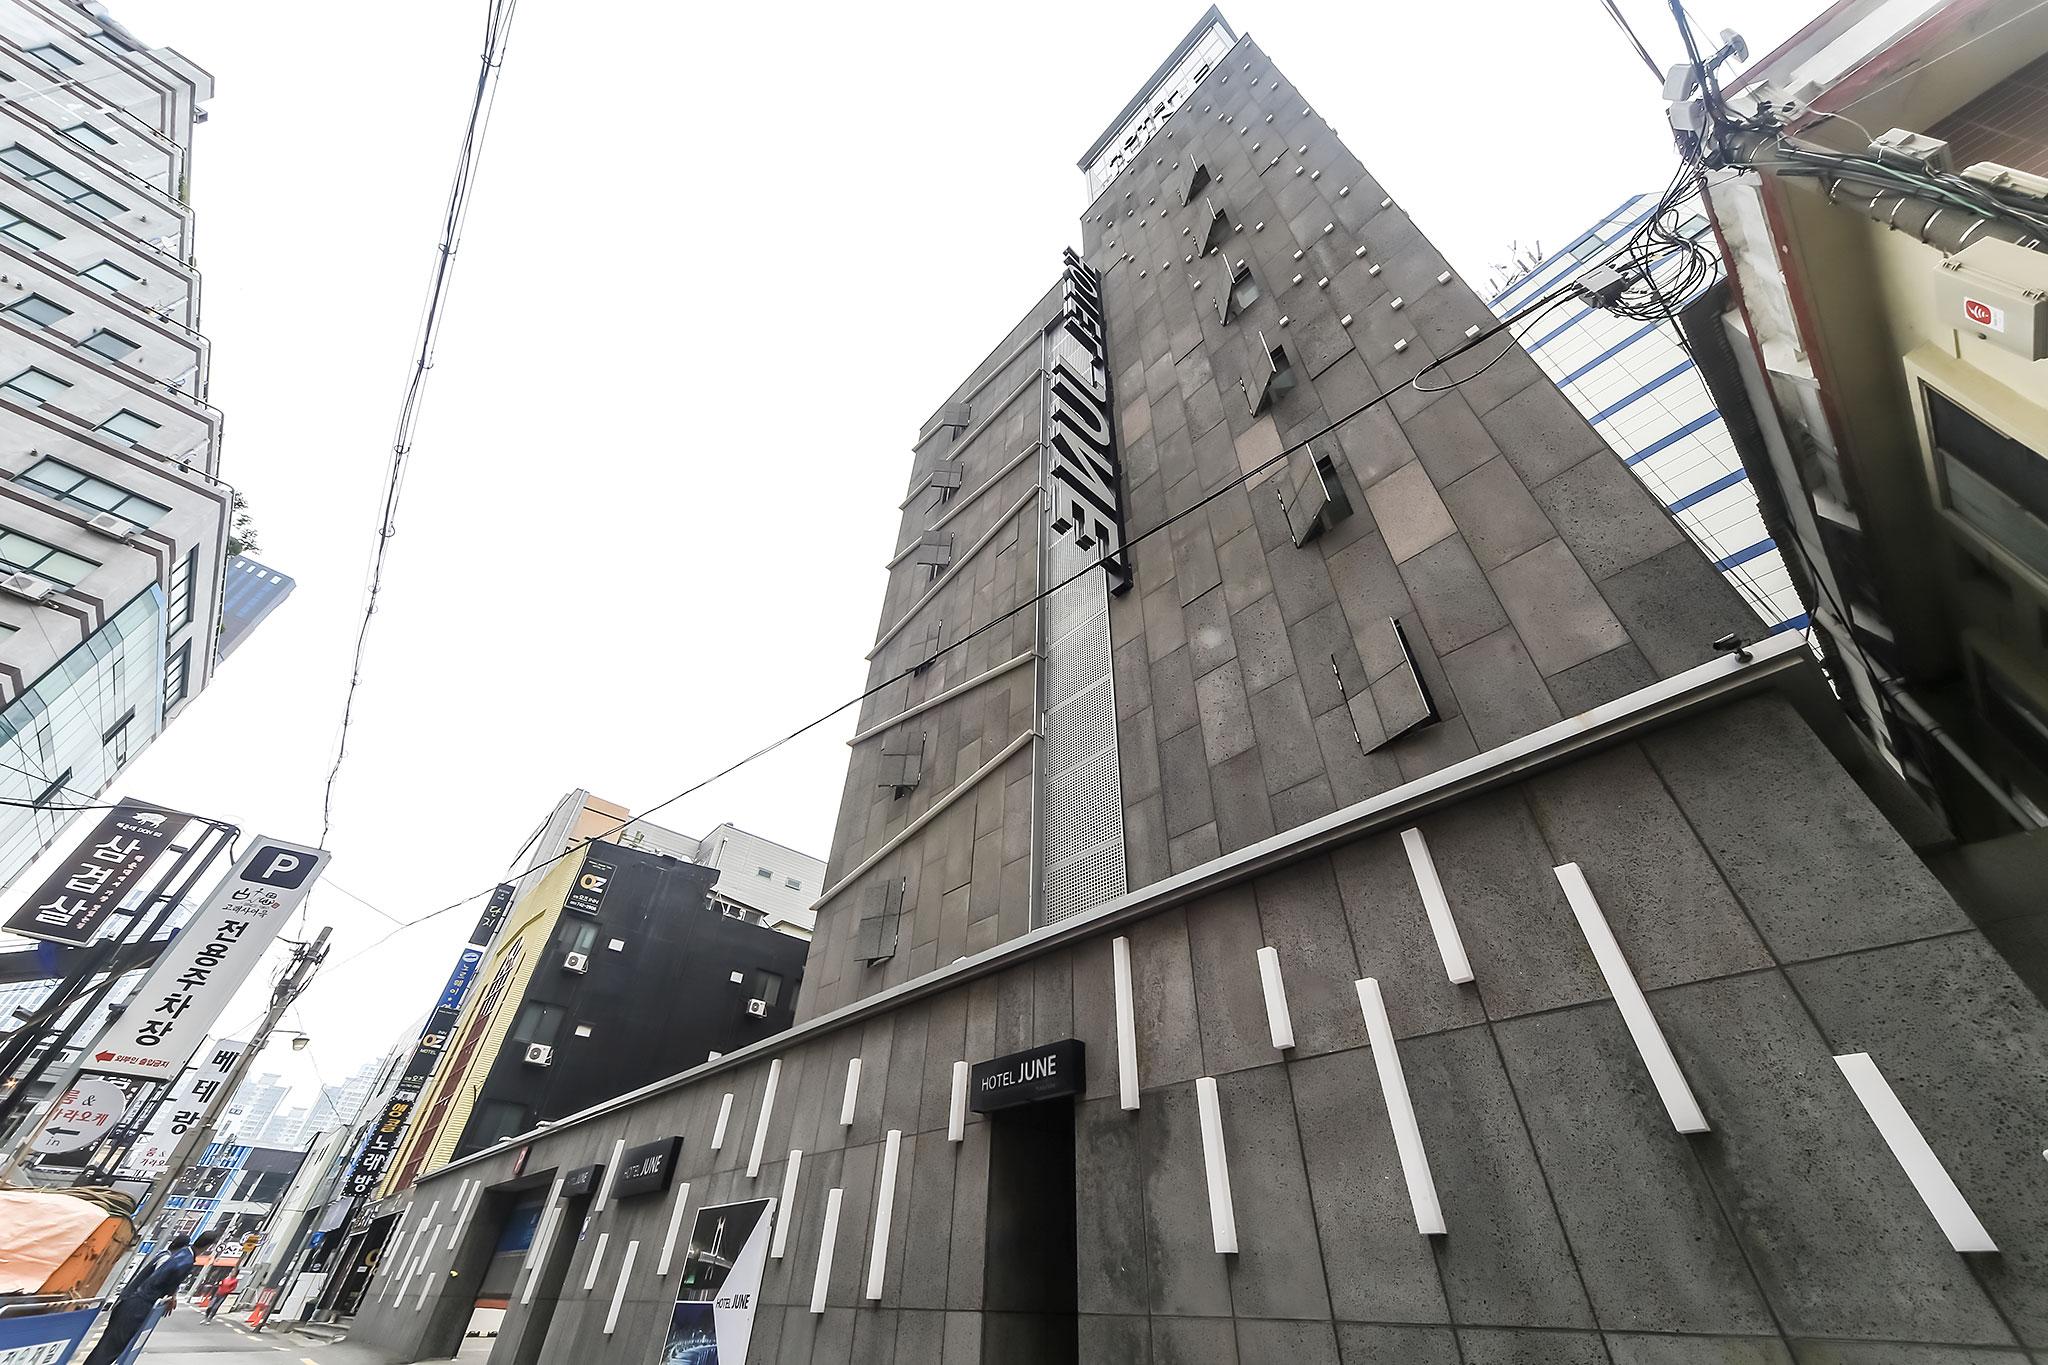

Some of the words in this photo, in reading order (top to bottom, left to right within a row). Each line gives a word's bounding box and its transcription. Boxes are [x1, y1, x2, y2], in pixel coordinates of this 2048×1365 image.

[262, 853, 300, 879] P
[38, 835, 142, 927] 삼겹살
[580, 873, 608, 894] OZ
[135, 919, 250, 1046] 전용주차장
[422, 1033, 447, 1049] OZ
[981, 1071, 1015, 1092] HOTEL
[1017, 1054, 1058, 1084] JUNE
[171, 1050, 240, 1135] 베테랑
[46, 1136, 61, 1147] in
[353, 1135, 389, 1193] 노래방
[639, 1154, 664, 1178] JUNE
[715, 1298, 731, 1310] HOTEL
[730, 1294, 751, 1310] JUNE
